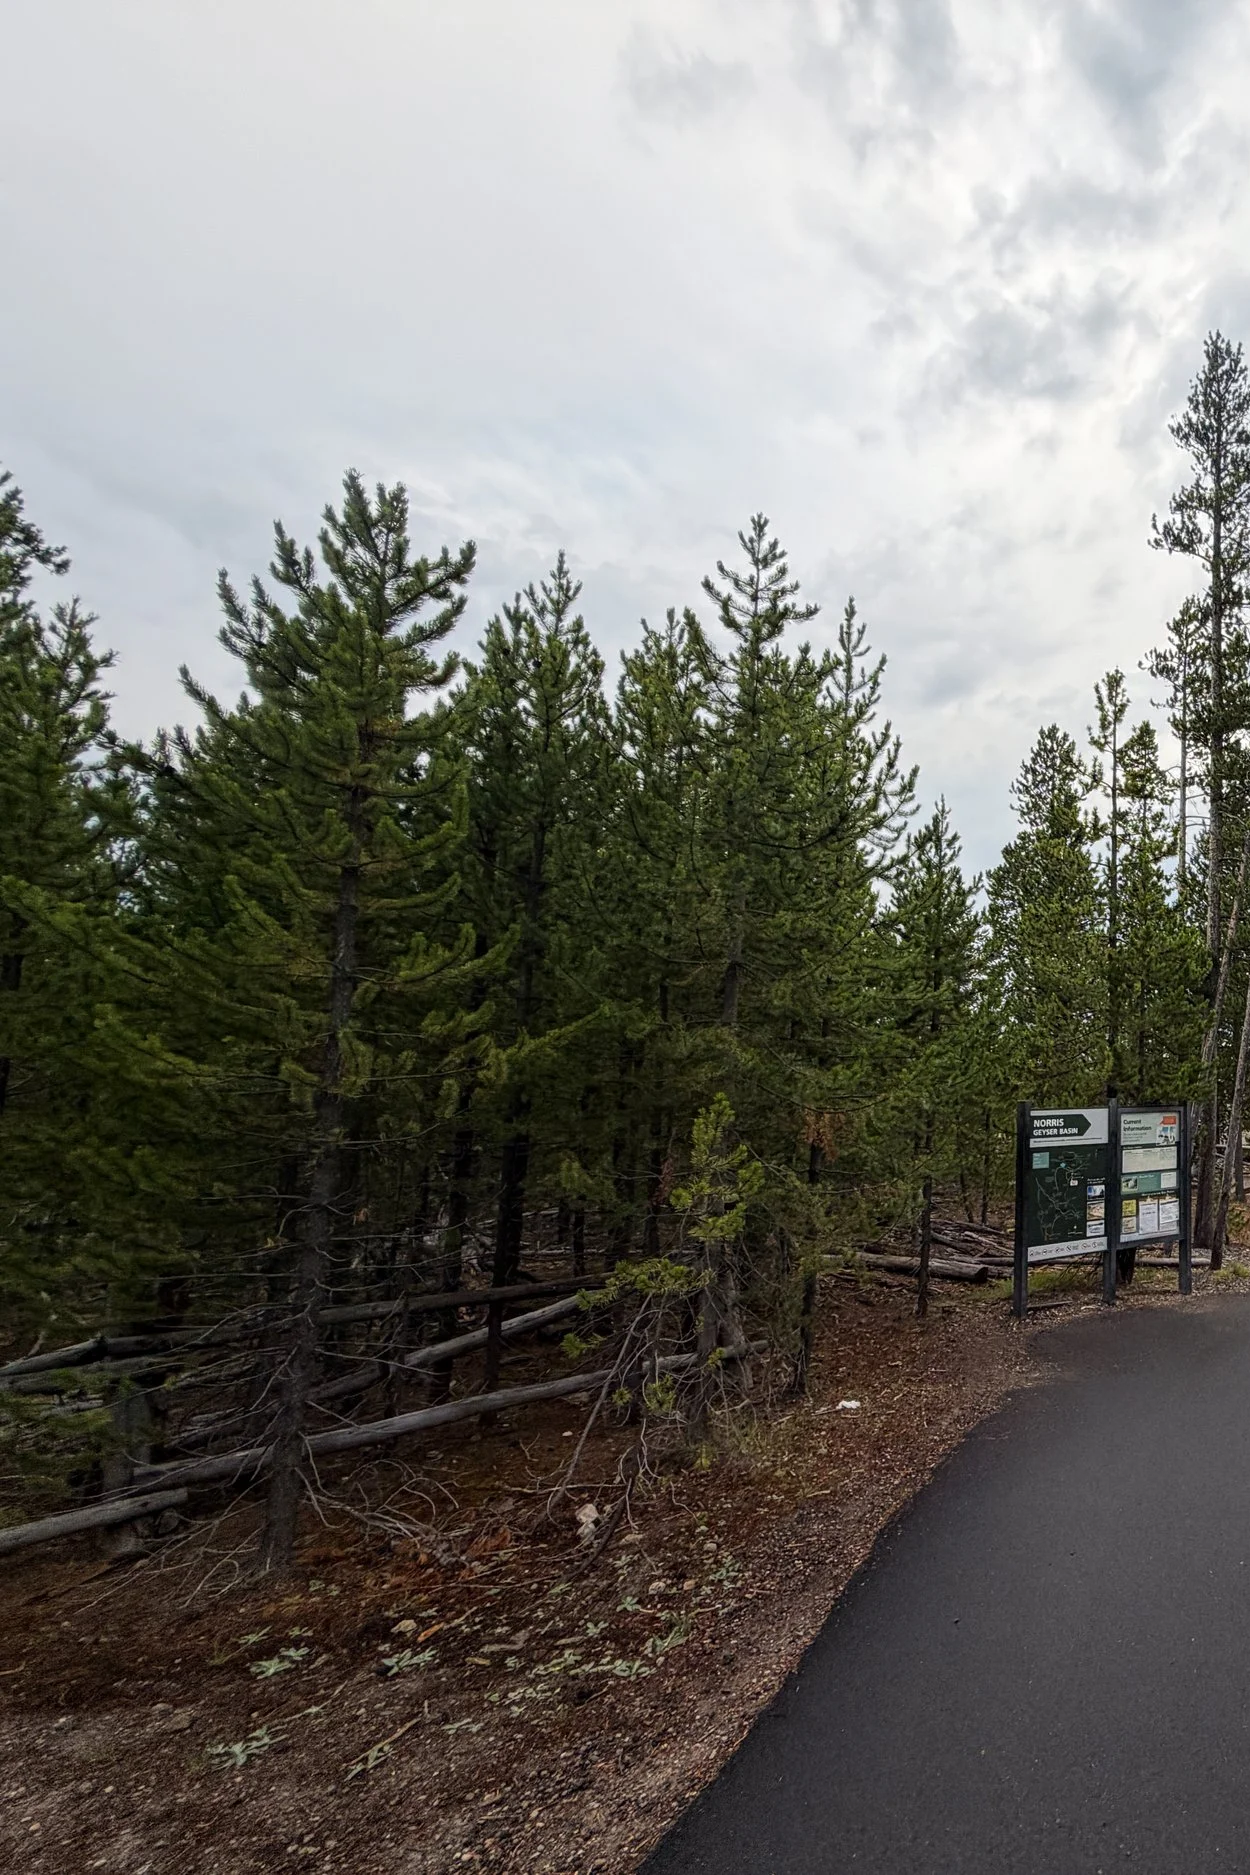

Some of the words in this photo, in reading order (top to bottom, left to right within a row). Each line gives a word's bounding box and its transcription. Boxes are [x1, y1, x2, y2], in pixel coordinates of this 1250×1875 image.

[1033, 1118, 1064, 1128] NORRIS
[1033, 1128, 1058, 1136] GEYSER
[1059, 1127, 1079, 1135] BASIN
